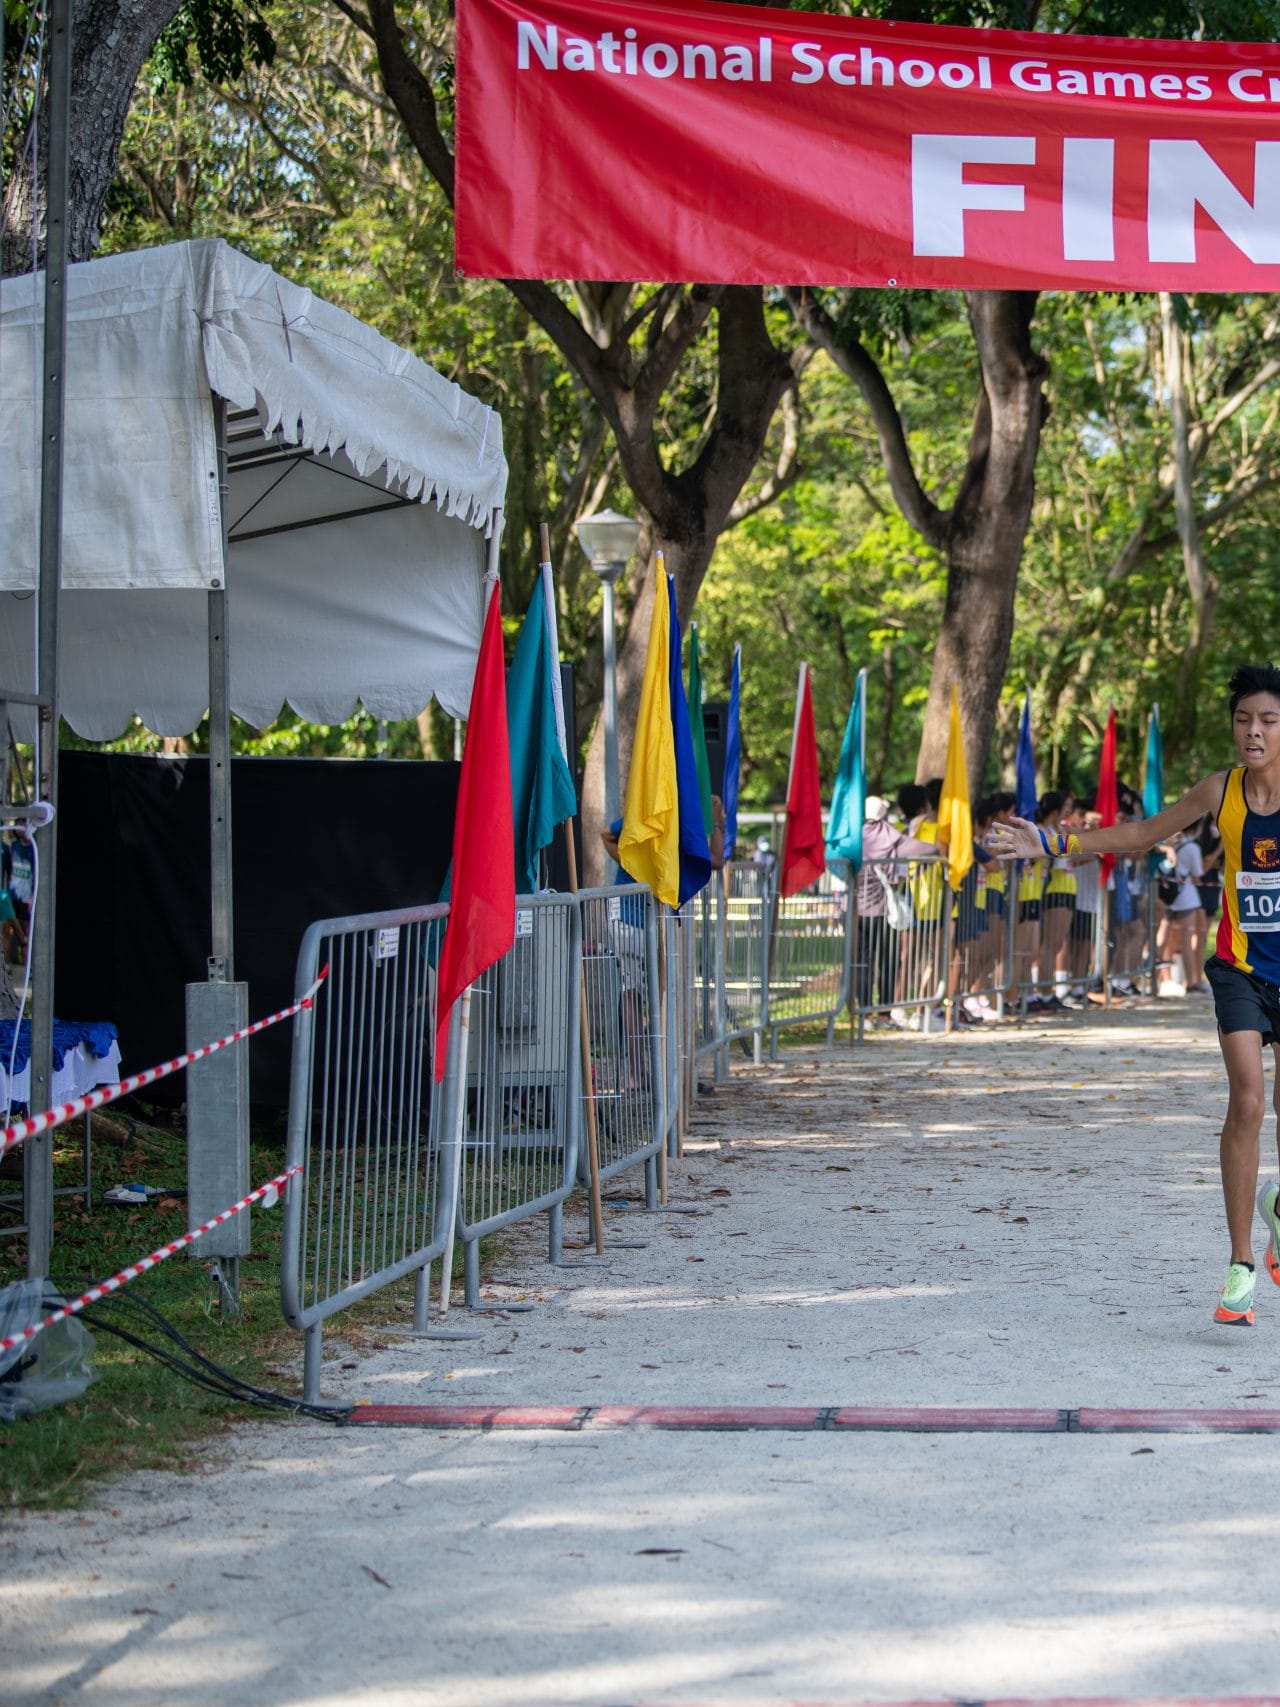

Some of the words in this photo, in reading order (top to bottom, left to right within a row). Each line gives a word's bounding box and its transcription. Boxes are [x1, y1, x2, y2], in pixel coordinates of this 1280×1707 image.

[518, 21, 773, 83] National
[791, 43, 992, 89] School
[1009, 60, 1212, 101] Games
